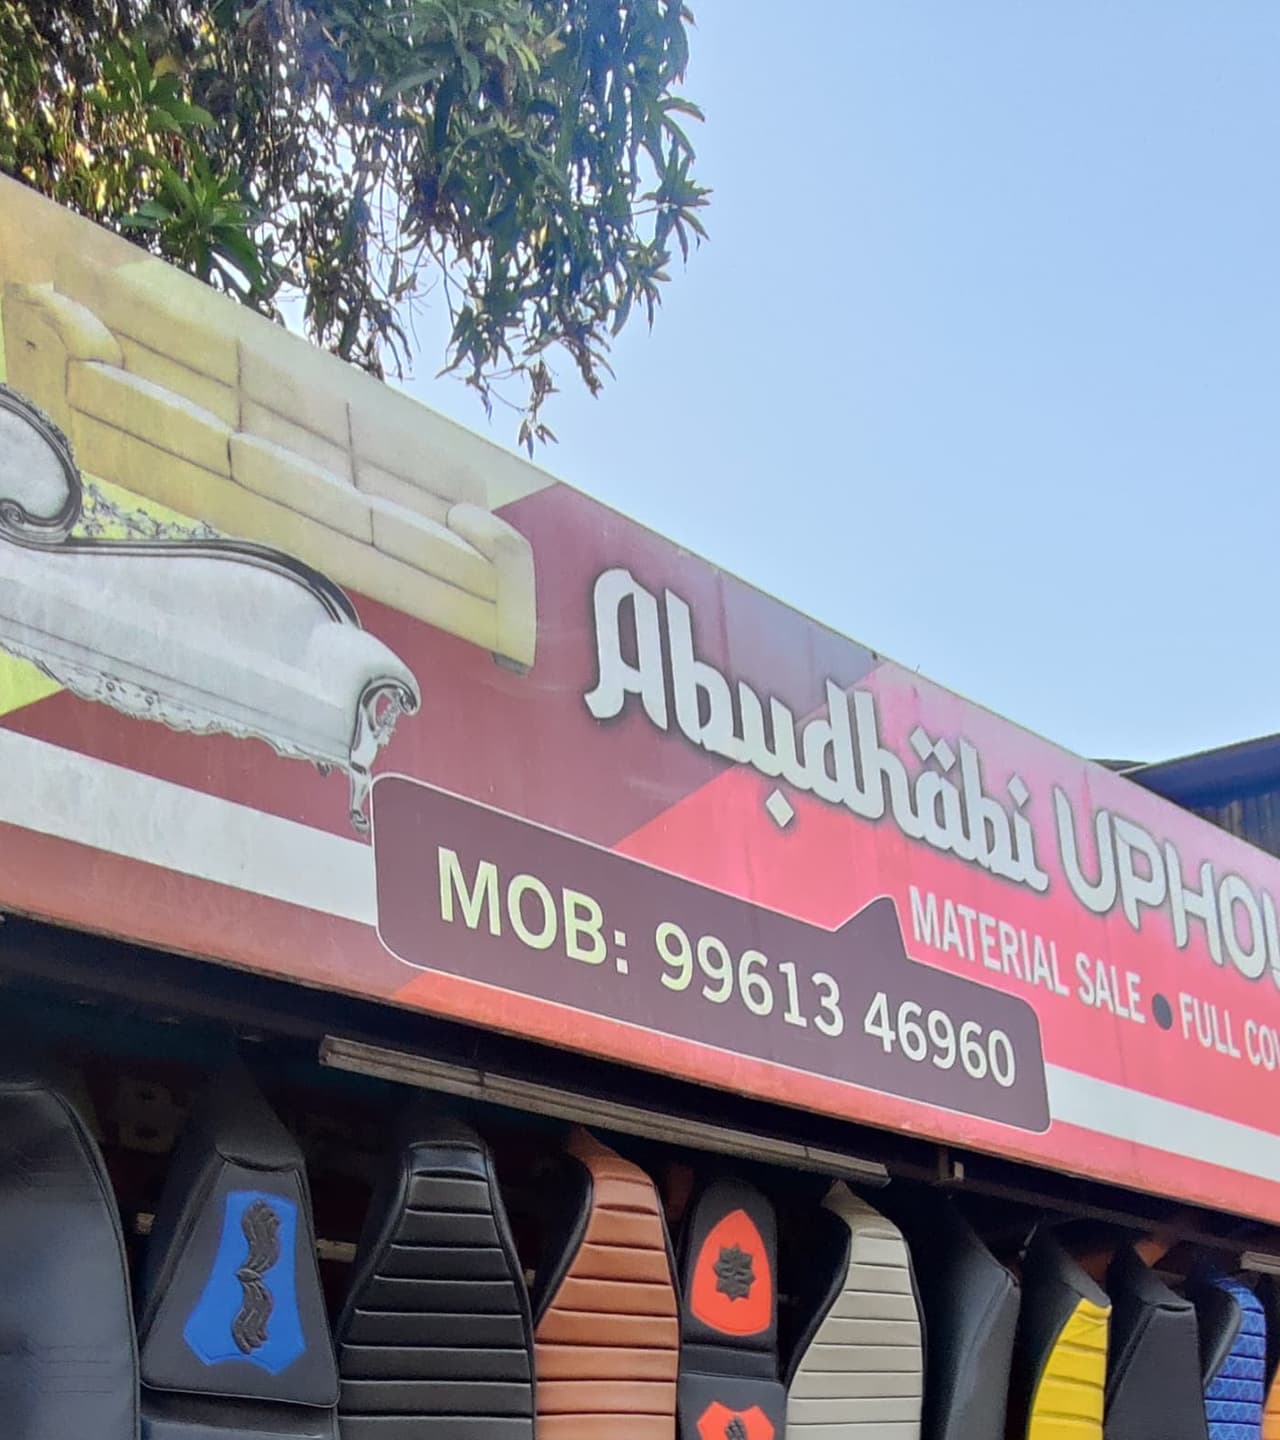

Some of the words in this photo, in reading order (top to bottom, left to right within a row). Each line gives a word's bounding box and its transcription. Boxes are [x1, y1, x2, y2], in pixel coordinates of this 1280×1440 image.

[437, 847, 630, 974] MOB:
[654, 922, 845, 1037] 99613
[863, 992, 1017, 1087] 46960
[908, 884, 1070, 997] MATERIAL
[1075, 951, 1146, 1024] SALE
[1178, 991, 1241, 1059] FULL
